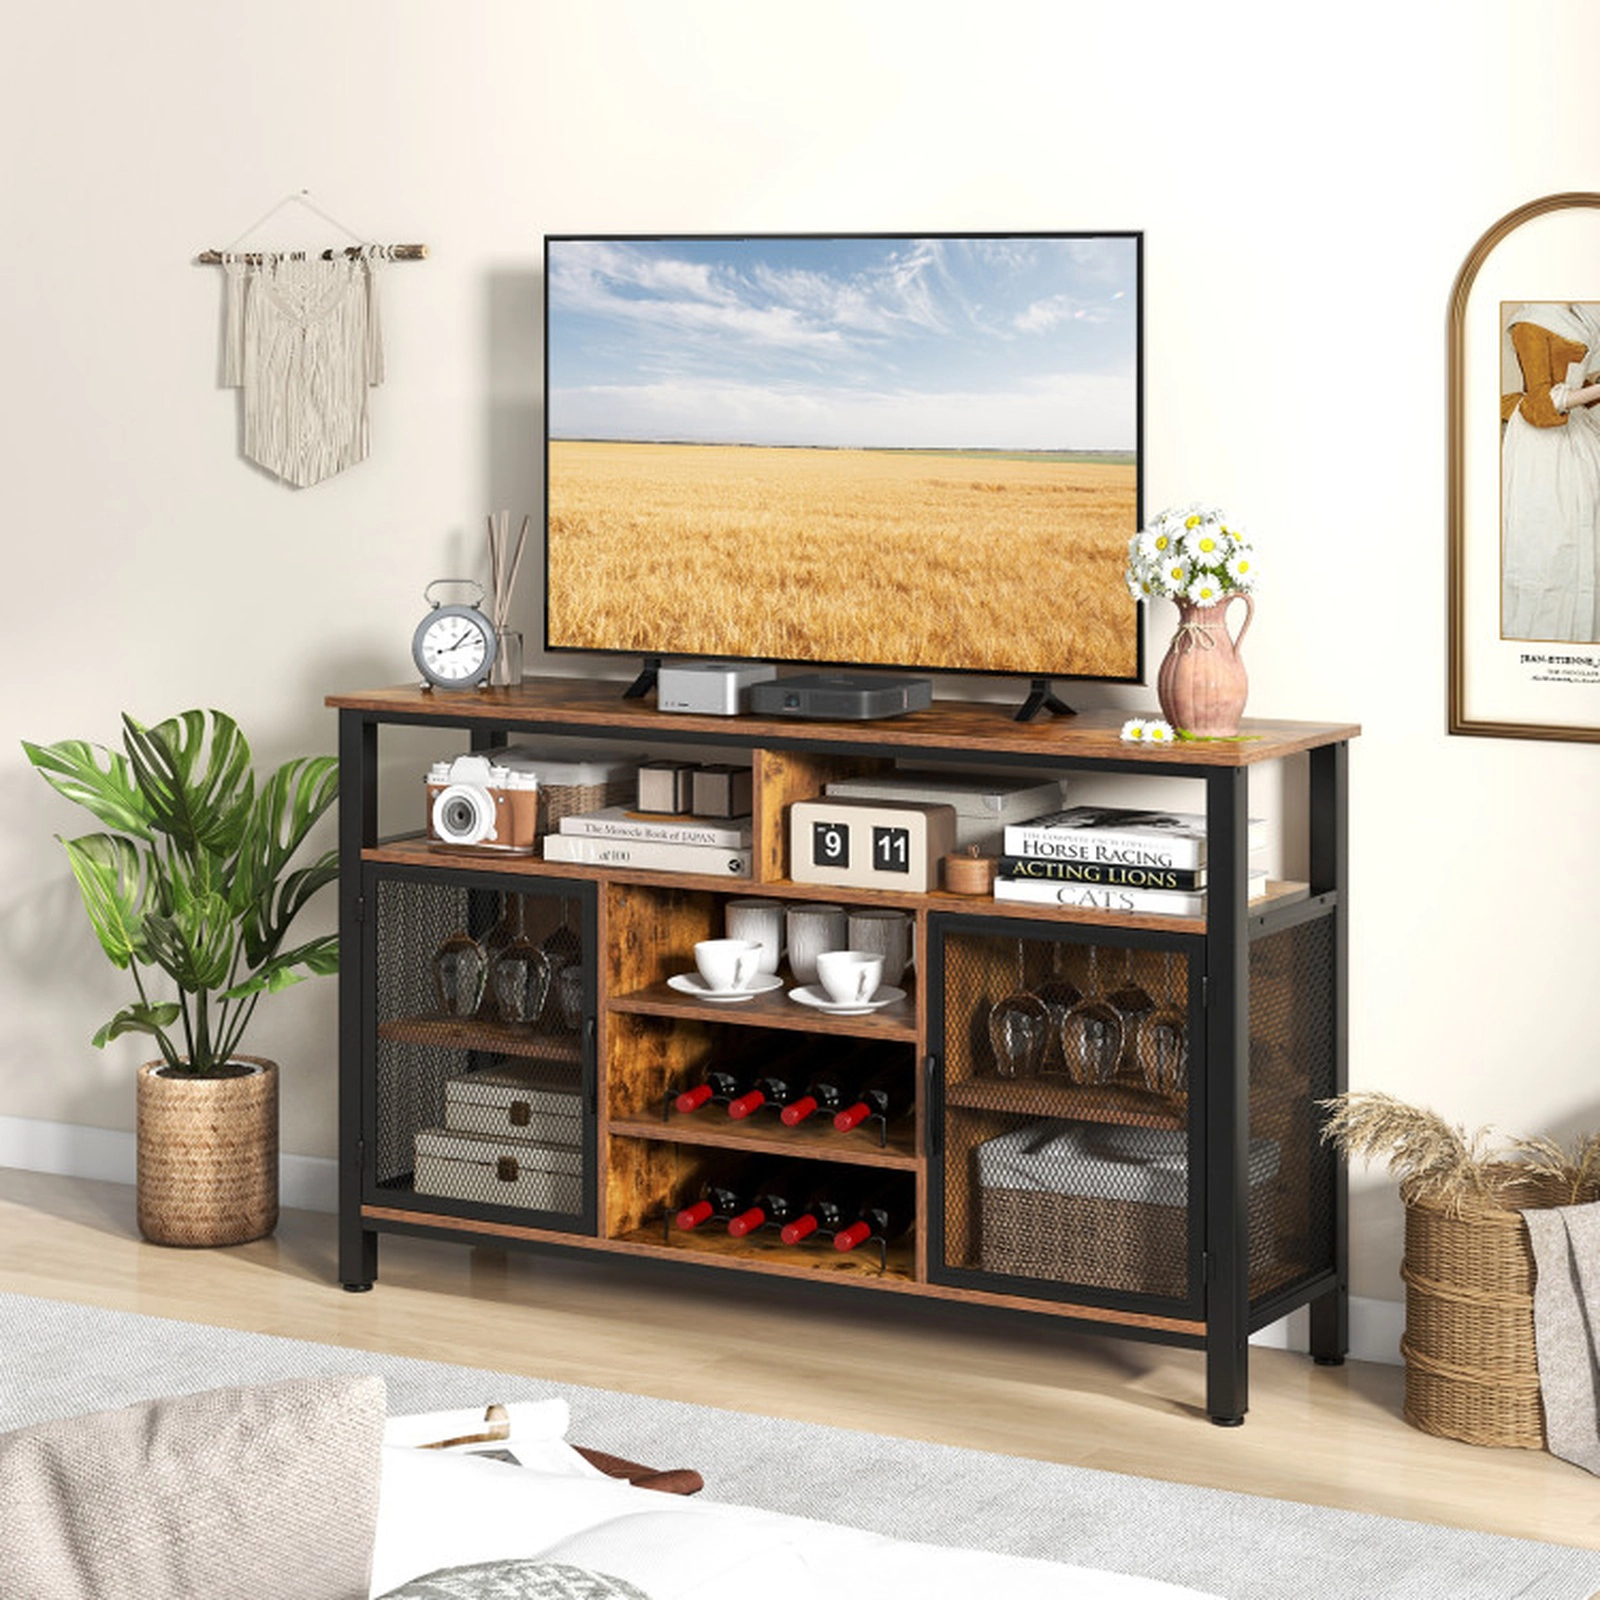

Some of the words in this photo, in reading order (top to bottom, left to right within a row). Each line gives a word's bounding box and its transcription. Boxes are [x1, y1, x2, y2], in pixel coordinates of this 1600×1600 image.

[584, 823, 602, 834] The
[645, 828, 668, 839] Book
[681, 831, 716, 844] JAPAN
[825, 831, 842, 857] 9
[877, 835, 906, 863] 11
[1023, 839, 1089, 860] HORSE
[1096, 845, 1173, 868] RACING
[1012, 860, 1101, 882] ACTING
[1108, 867, 1178, 888] LIONS
[1056, 886, 1135, 911] CATS
